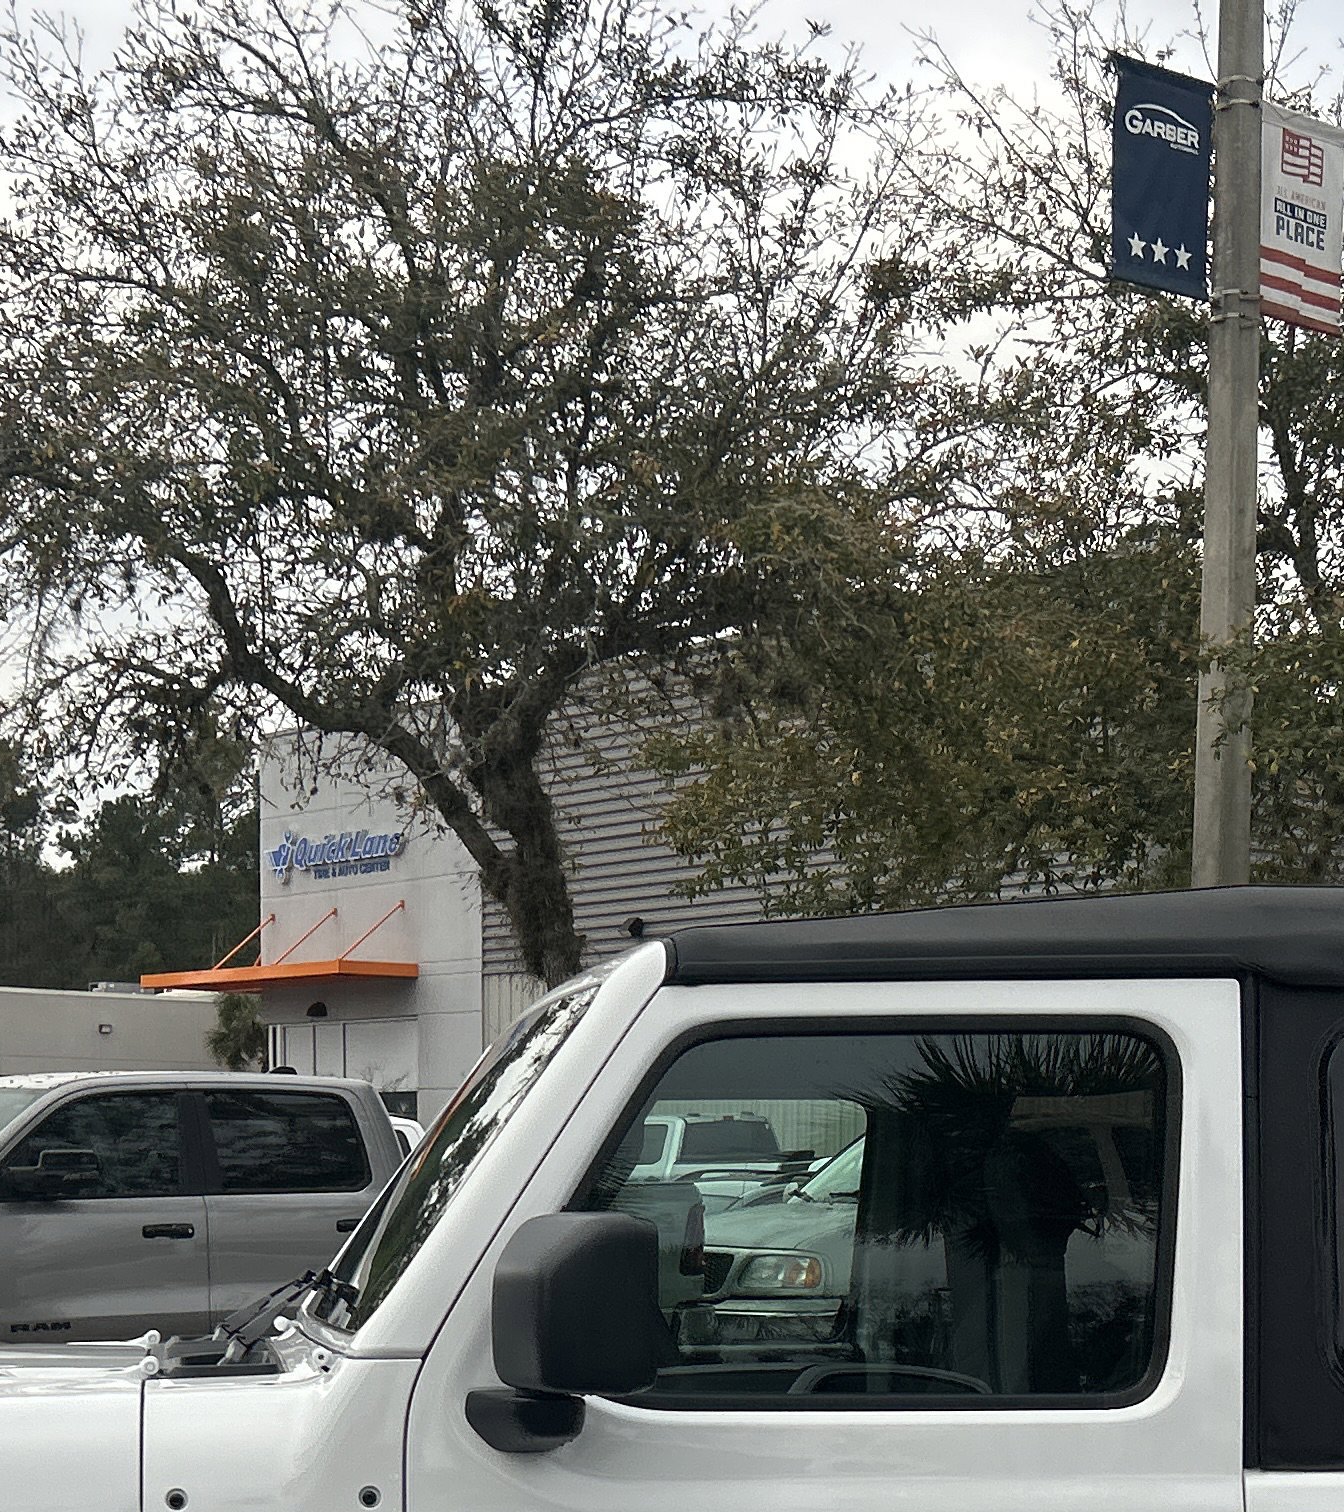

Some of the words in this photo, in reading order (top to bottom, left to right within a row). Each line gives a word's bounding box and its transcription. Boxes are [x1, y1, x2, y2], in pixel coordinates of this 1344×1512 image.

[1124, 108, 1200, 149] GARBER
[1276, 200, 1293, 216] ALL
[1294, 207, 1305, 219] IN
[1306, 211, 1326, 228] ONE
[1276, 214, 1325, 251] PLACE
[293, 832, 350, 870] Quick
[350, 830, 401, 860] Lane
[10, 1321, 72, 1333] RAM
